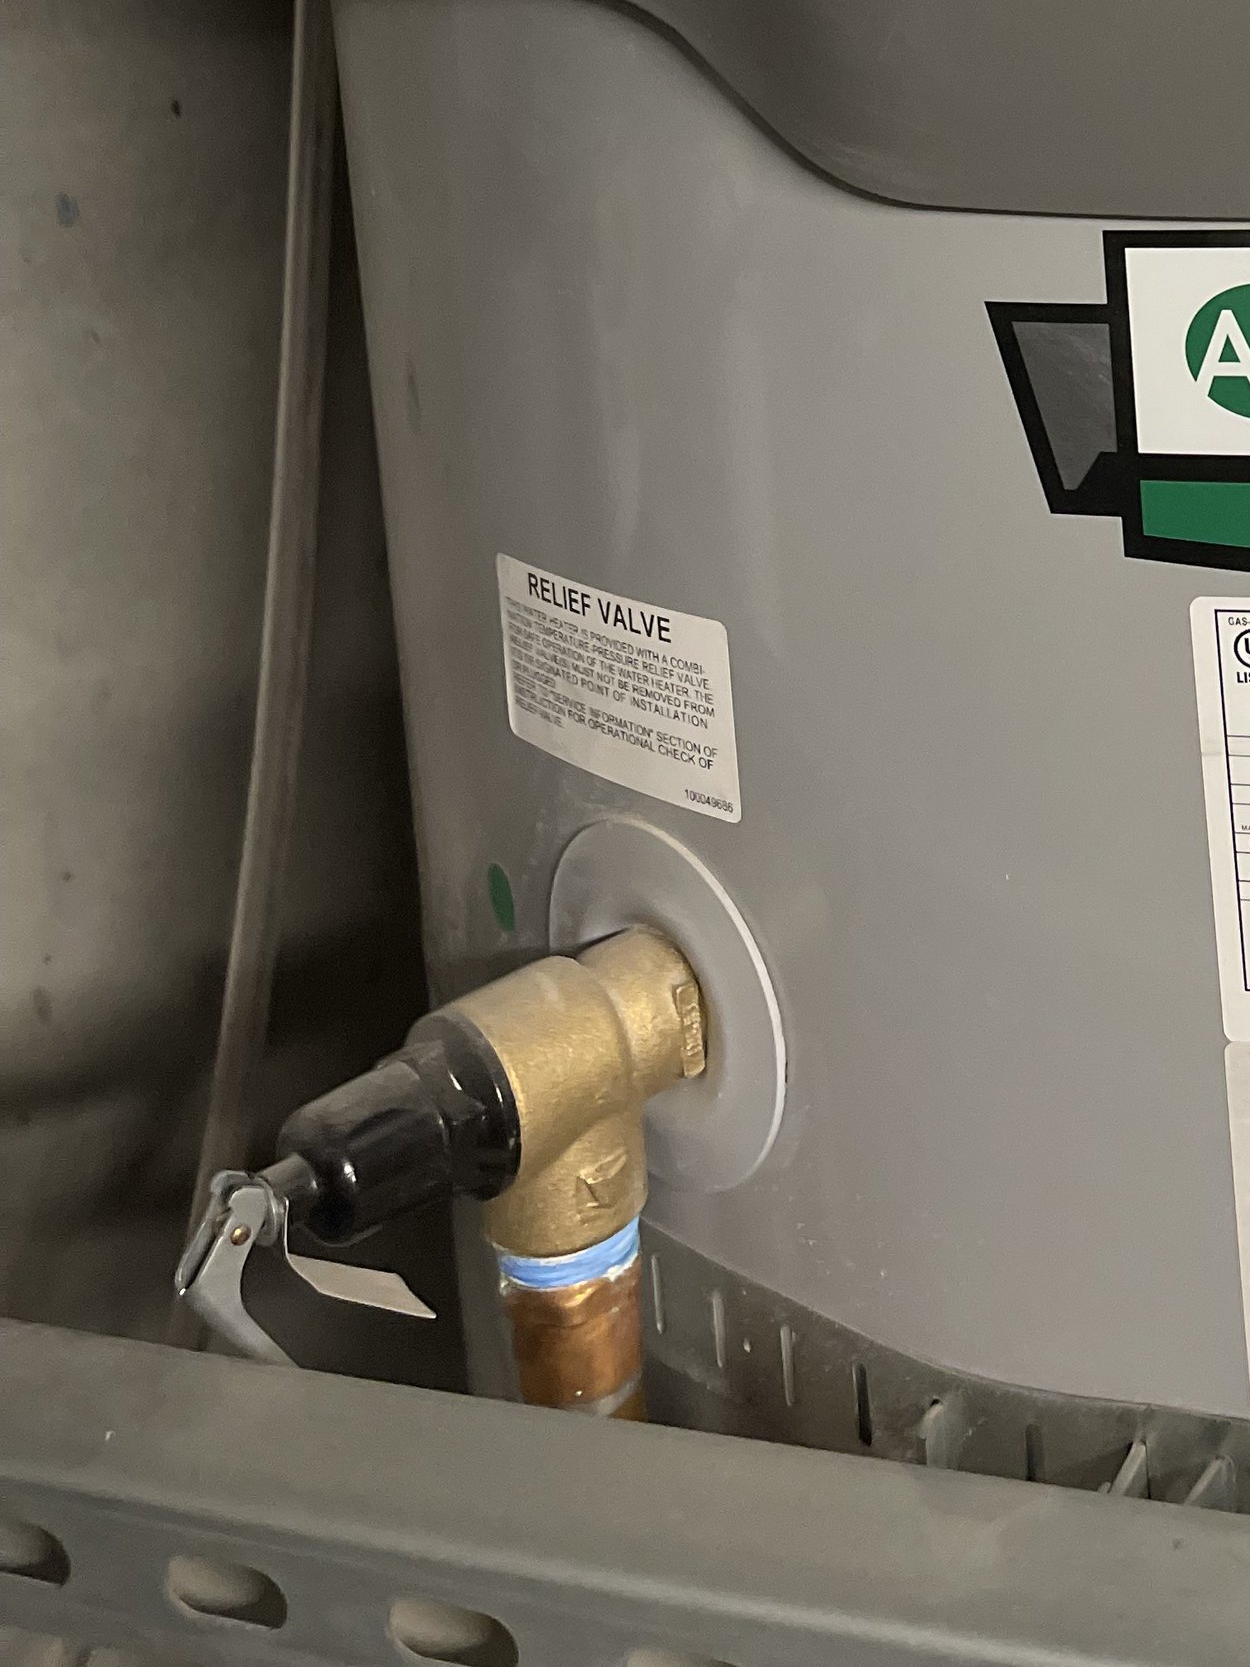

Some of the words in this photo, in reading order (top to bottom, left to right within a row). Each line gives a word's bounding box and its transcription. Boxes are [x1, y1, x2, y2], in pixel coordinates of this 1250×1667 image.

[528, 573, 591, 616] RELIEF
[598, 598, 671, 643] VALVE
[678, 674, 709, 689] VALVE
[631, 697, 708, 729] INSTALLATION
[632, 686, 681, 708] REMOVED
[684, 701, 715, 717] FROM
[656, 730, 700, 753] SECTION
[658, 745, 695, 764] CHECK
